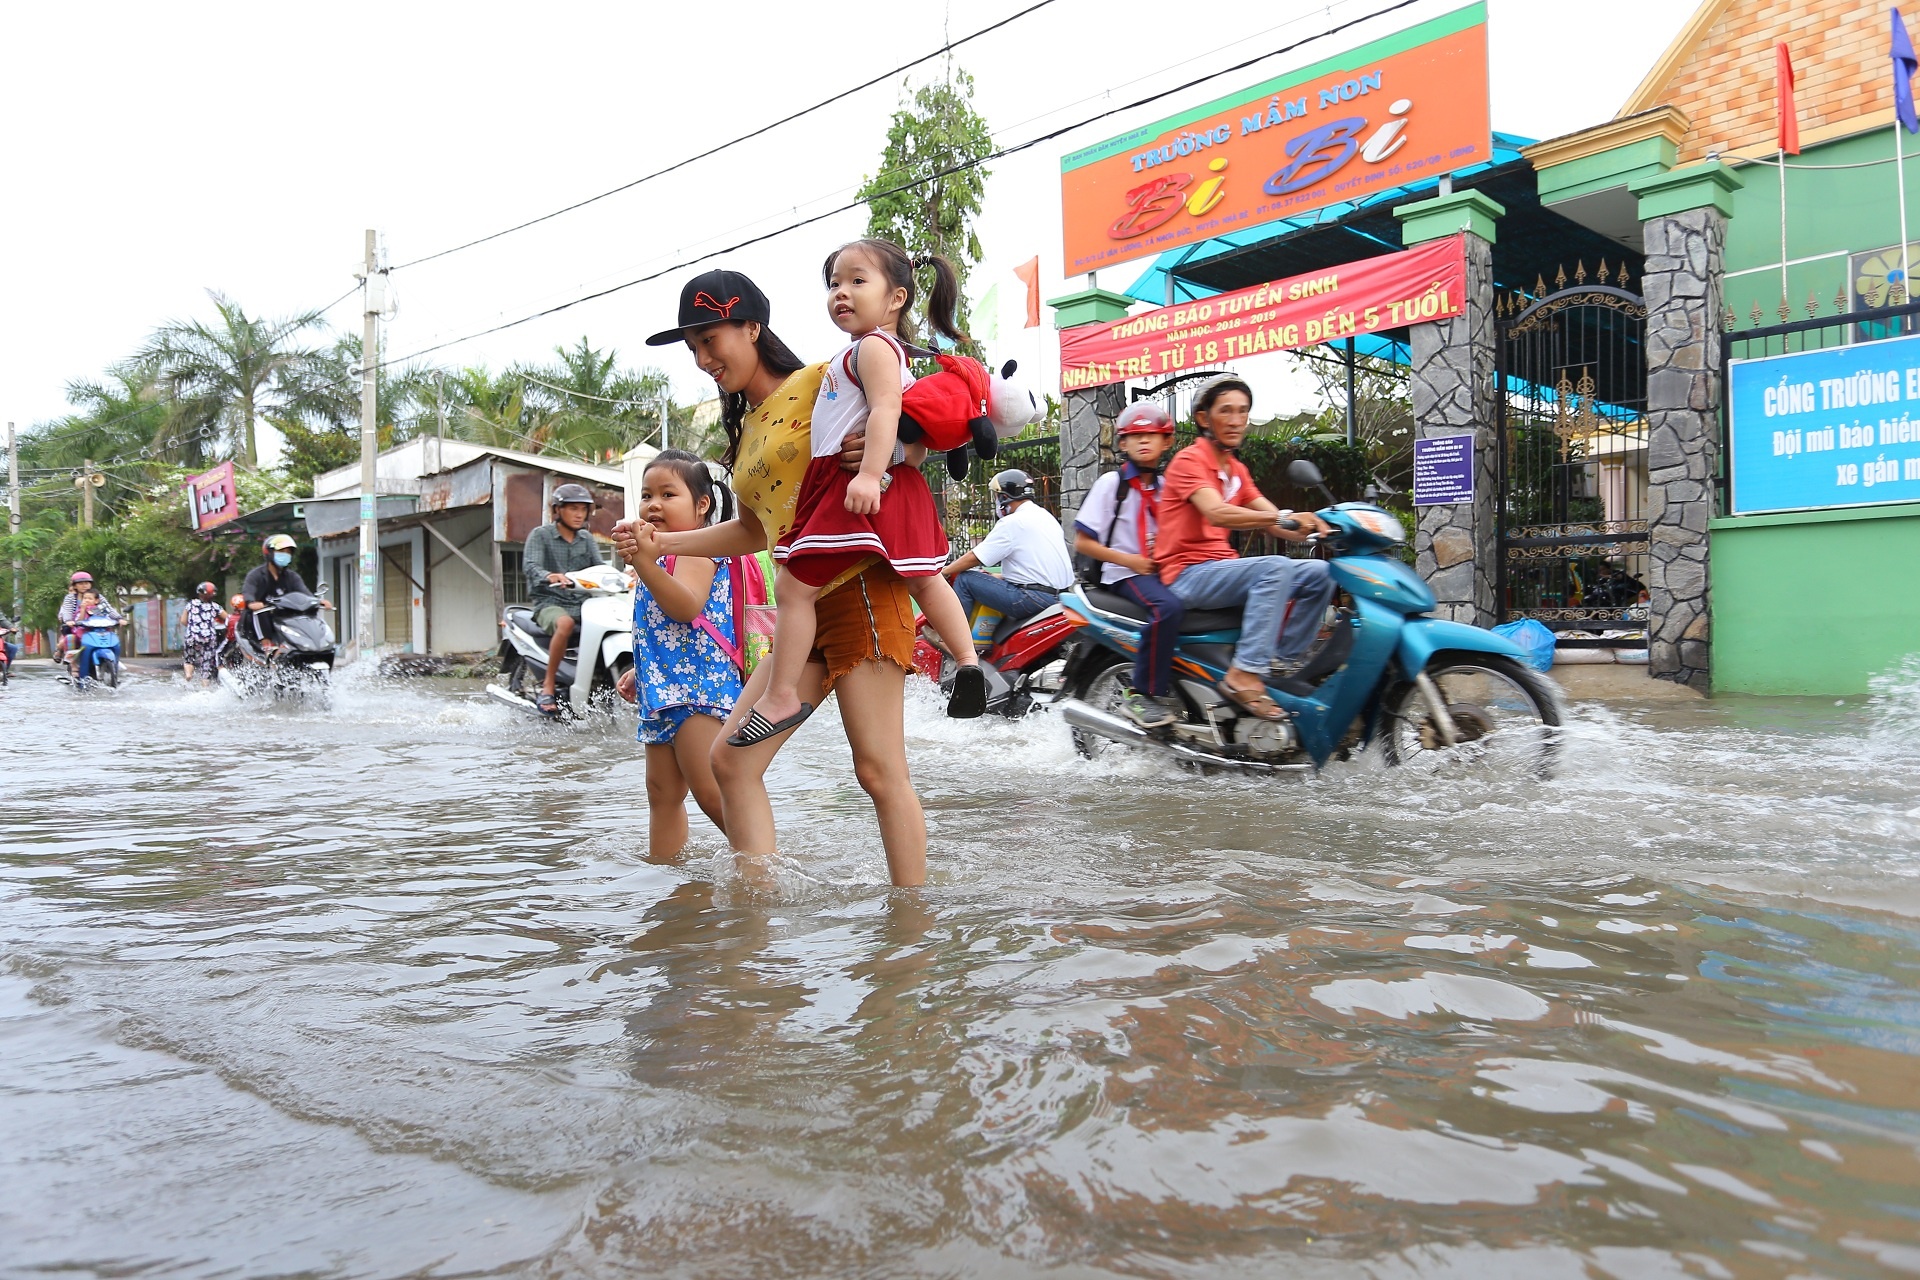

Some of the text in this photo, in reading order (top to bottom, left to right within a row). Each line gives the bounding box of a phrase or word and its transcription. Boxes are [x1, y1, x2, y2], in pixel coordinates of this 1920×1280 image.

[1130, 70, 1382, 172] TRƯỜNG MẦM NON
[1108, 98, 1413, 240] Bi Bi
[1062, 282, 1458, 388] NHẬN TRẺ TỪ 18 THÁNG ĐẾN 5 TUỔI.
[1111, 274, 1338, 340] THÔNG BÁO TUYỂN SINH
[1166, 328, 1188, 342] NĂM
[1216, 318, 1241, 332] 2018
[1250, 310, 1276, 325] 2019
[1764, 374, 1815, 418] CỔNG
[1820, 369, 1900, 410] TRƯỜNG
[1772, 428, 1802, 460] Đội
[1806, 425, 1834, 453] mũ
[1839, 420, 1874, 450] bảo
[1836, 463, 1858, 486] xe
[1863, 453, 1900, 488] gắn
